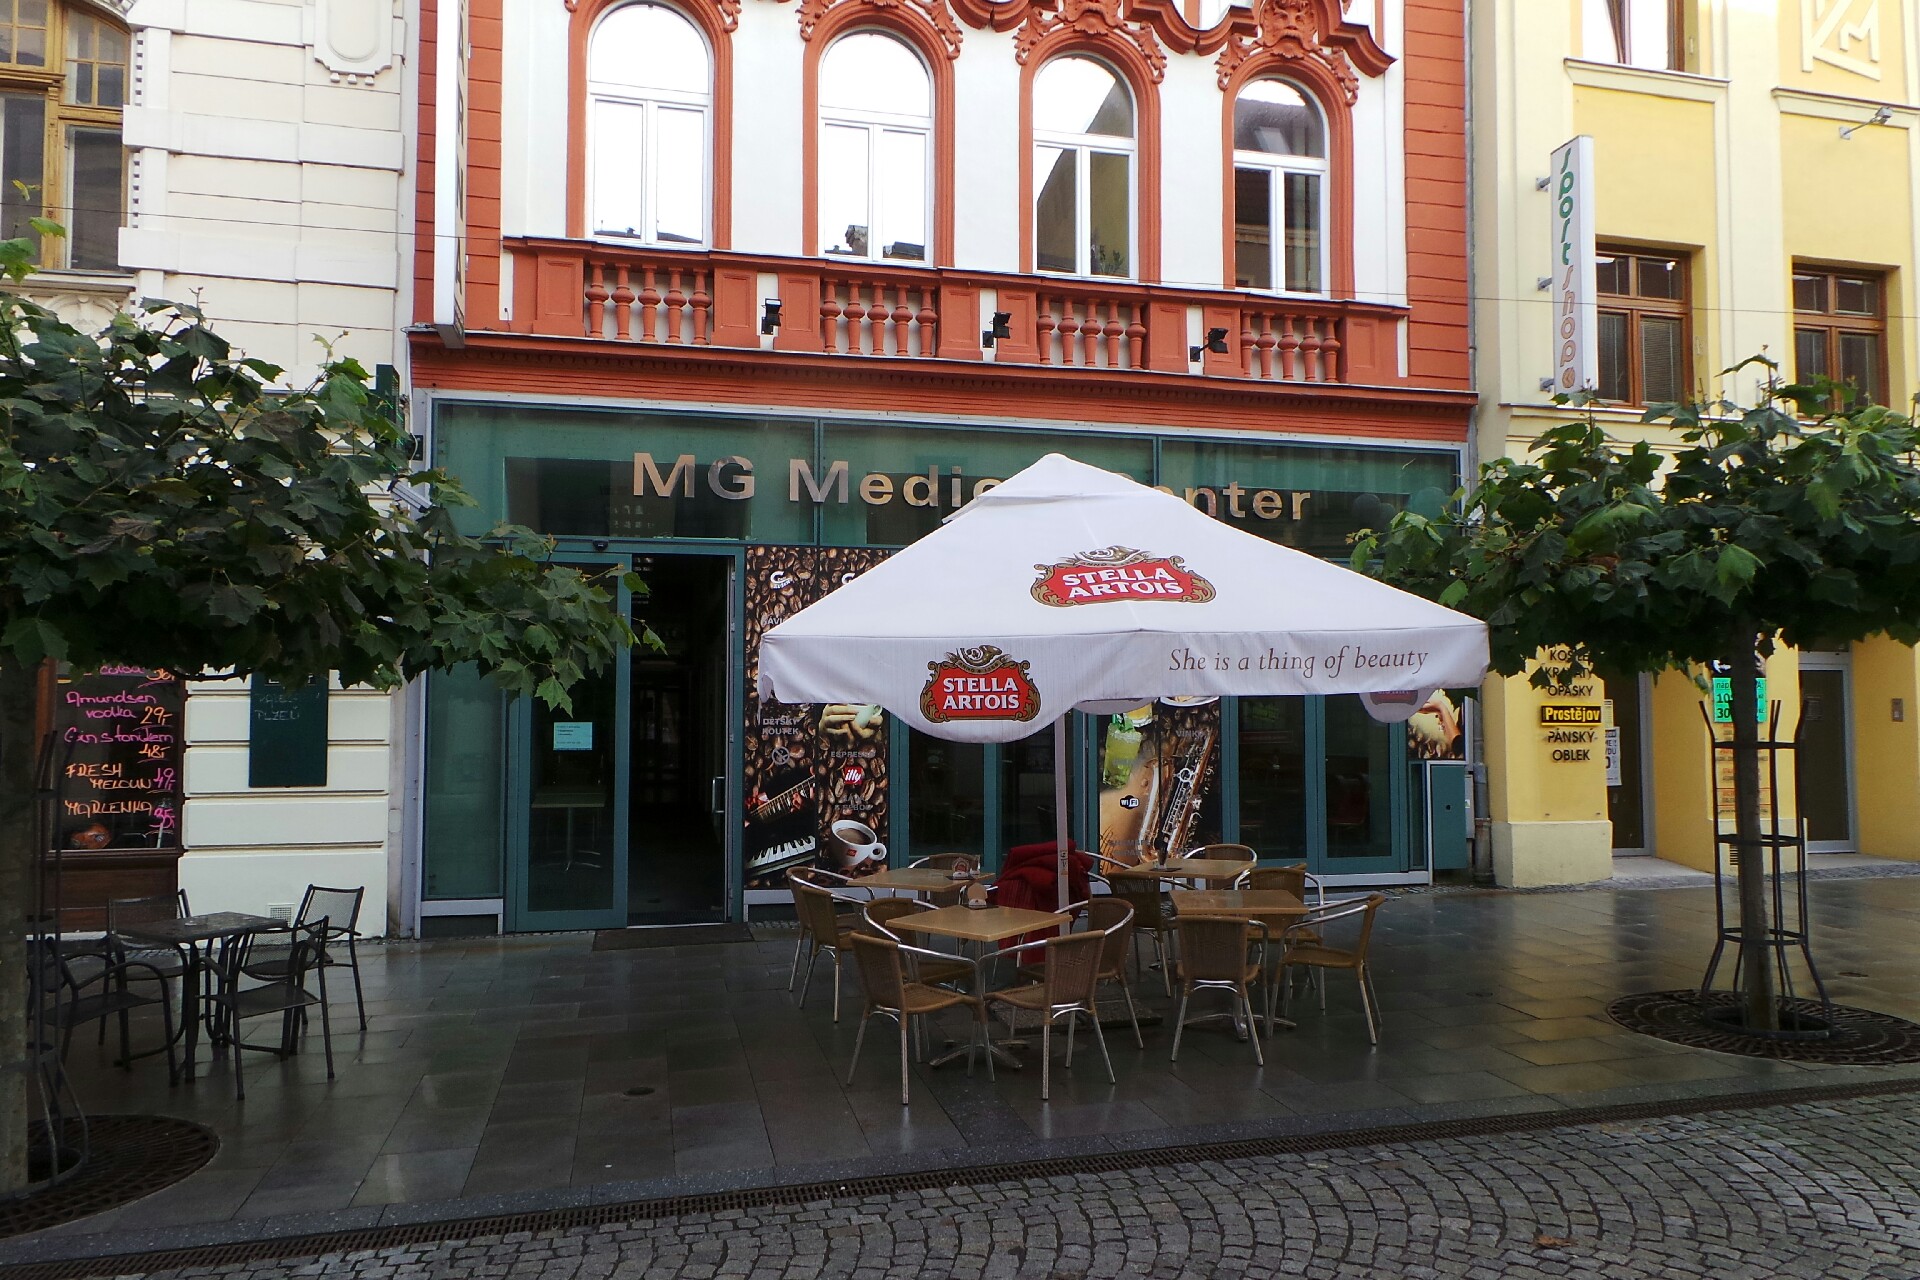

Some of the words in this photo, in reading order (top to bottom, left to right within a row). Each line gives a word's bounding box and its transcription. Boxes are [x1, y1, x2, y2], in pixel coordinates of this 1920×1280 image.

[1558, 147, 1574, 265] sport
[633, 452, 755, 500] MG
[1062, 567, 1176, 586] STELLA
[1068, 582, 1184, 599] ARTOIS
[1168, 648, 1206, 671] She
[1214, 652, 1230, 671] is
[1238, 657, 1250, 671] a
[1259, 647, 1315, 678] thing
[1324, 645, 1350, 678] of
[1355, 647, 1429, 675] beauty
[1550, 650, 1589, 661] KOLE
[1545, 667, 1593, 679] KRATY
[943, 677, 1019, 692] STELLA
[66, 690, 157, 707] Amundsen
[943, 694, 1020, 709] ARTOIS
[86, 706, 137, 719] vodka
[1545, 707, 1600, 722] Prostějov
[762, 727, 799, 735] KOUTEK
[1548, 728, 1594, 743] PÁNSKÝ
[1552, 749, 1590, 761] OBLEK
[65, 763, 122, 778] FRESH
[845, 769, 861, 784] illy
[89, 779, 152, 789] MELOUN
[65, 800, 153, 818] MARLENKA
